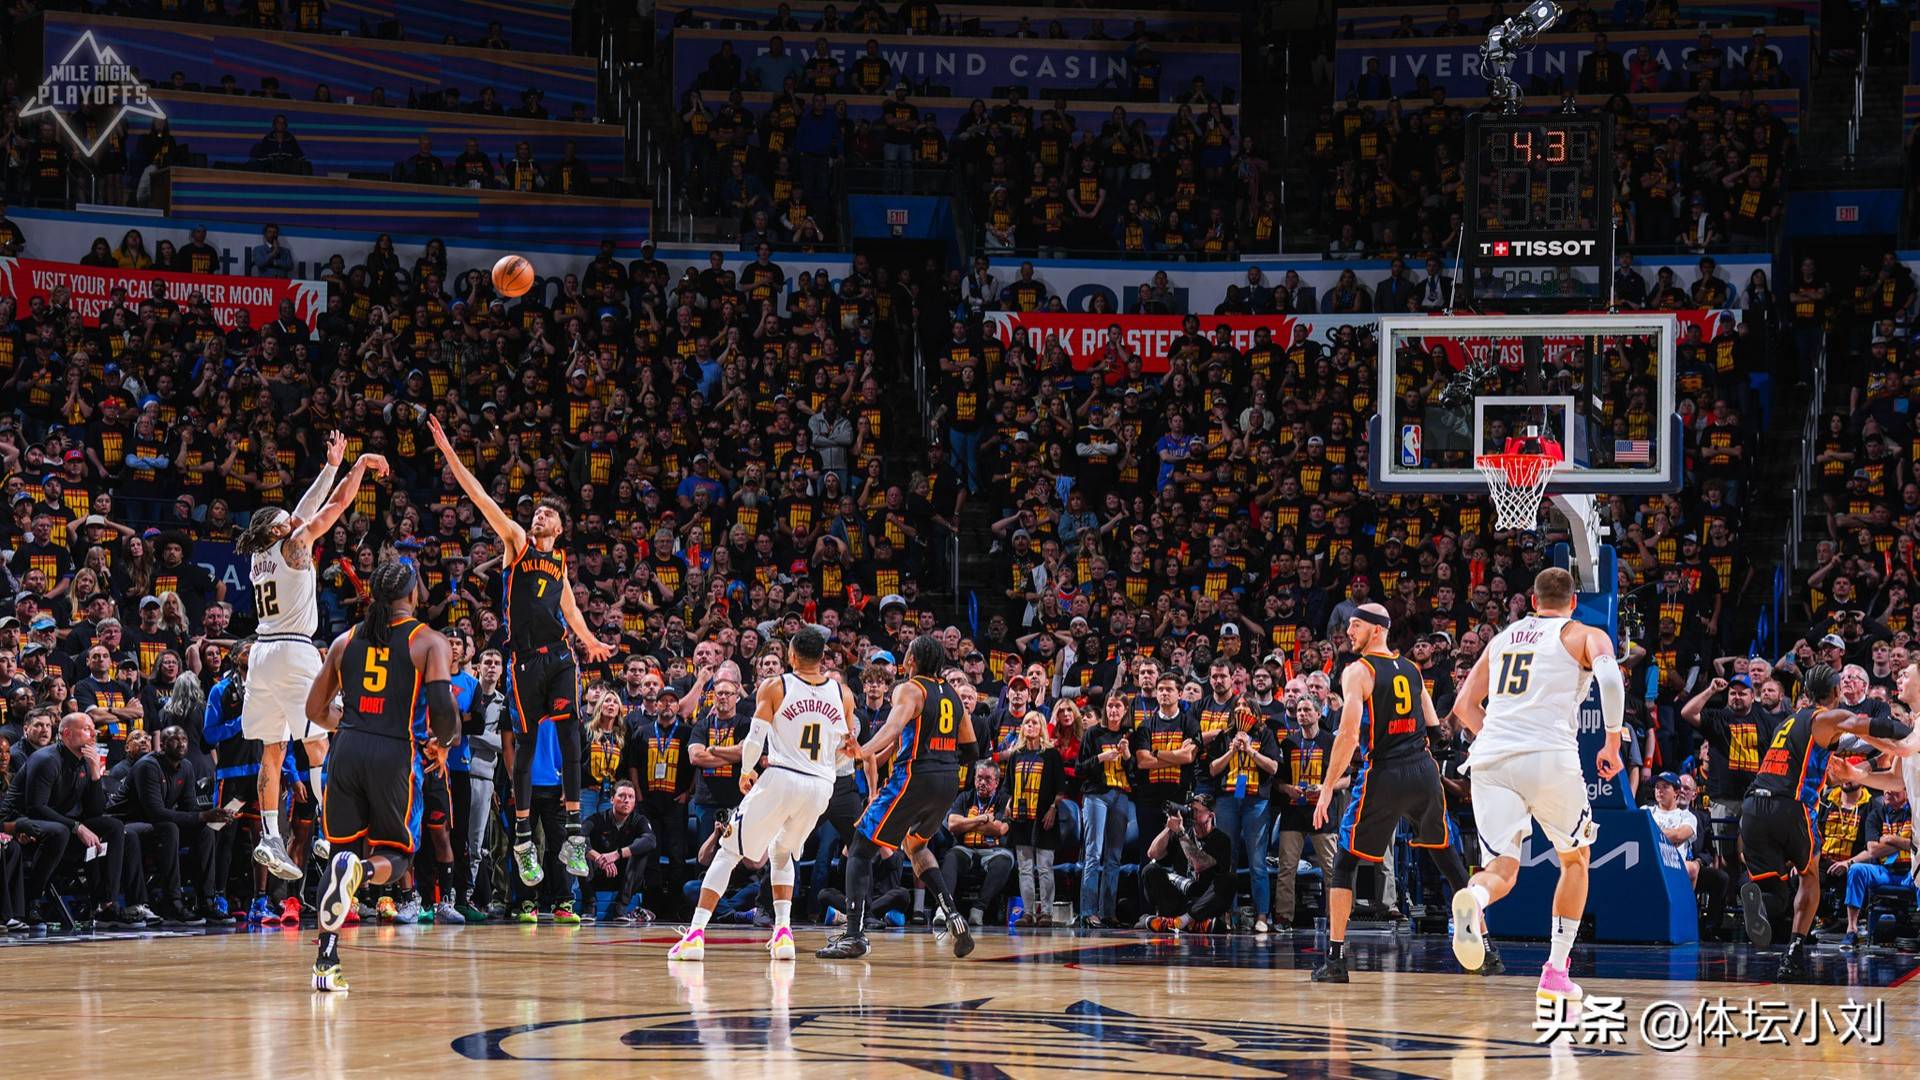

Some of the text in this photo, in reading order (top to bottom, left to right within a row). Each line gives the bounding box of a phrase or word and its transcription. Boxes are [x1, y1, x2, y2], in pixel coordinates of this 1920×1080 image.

[1008, 54, 1128, 80] CASIN
[1512, 129, 1567, 163] 4.3
[1511, 240, 1596, 257] TISSOT
[32, 270, 67, 291] VISIT
[69, 273, 106, 297] YOUR
[229, 285, 273, 307] MOON
[252, 560, 278, 578] ORDON
[521, 558, 562, 582] OKLAHOMA
[537, 577, 548, 598] 7
[362, 645, 391, 693] 5
[1496, 652, 1536, 696] 15
[359, 695, 386, 715] DORT
[1392, 674, 1412, 716] 9
[781, 699, 842, 726] WESTBROOK
[938, 697, 954, 735] 8
[1577, 709, 1601, 734] pp
[800, 722, 822, 762] 4
[1770, 717, 1796, 749] 2
